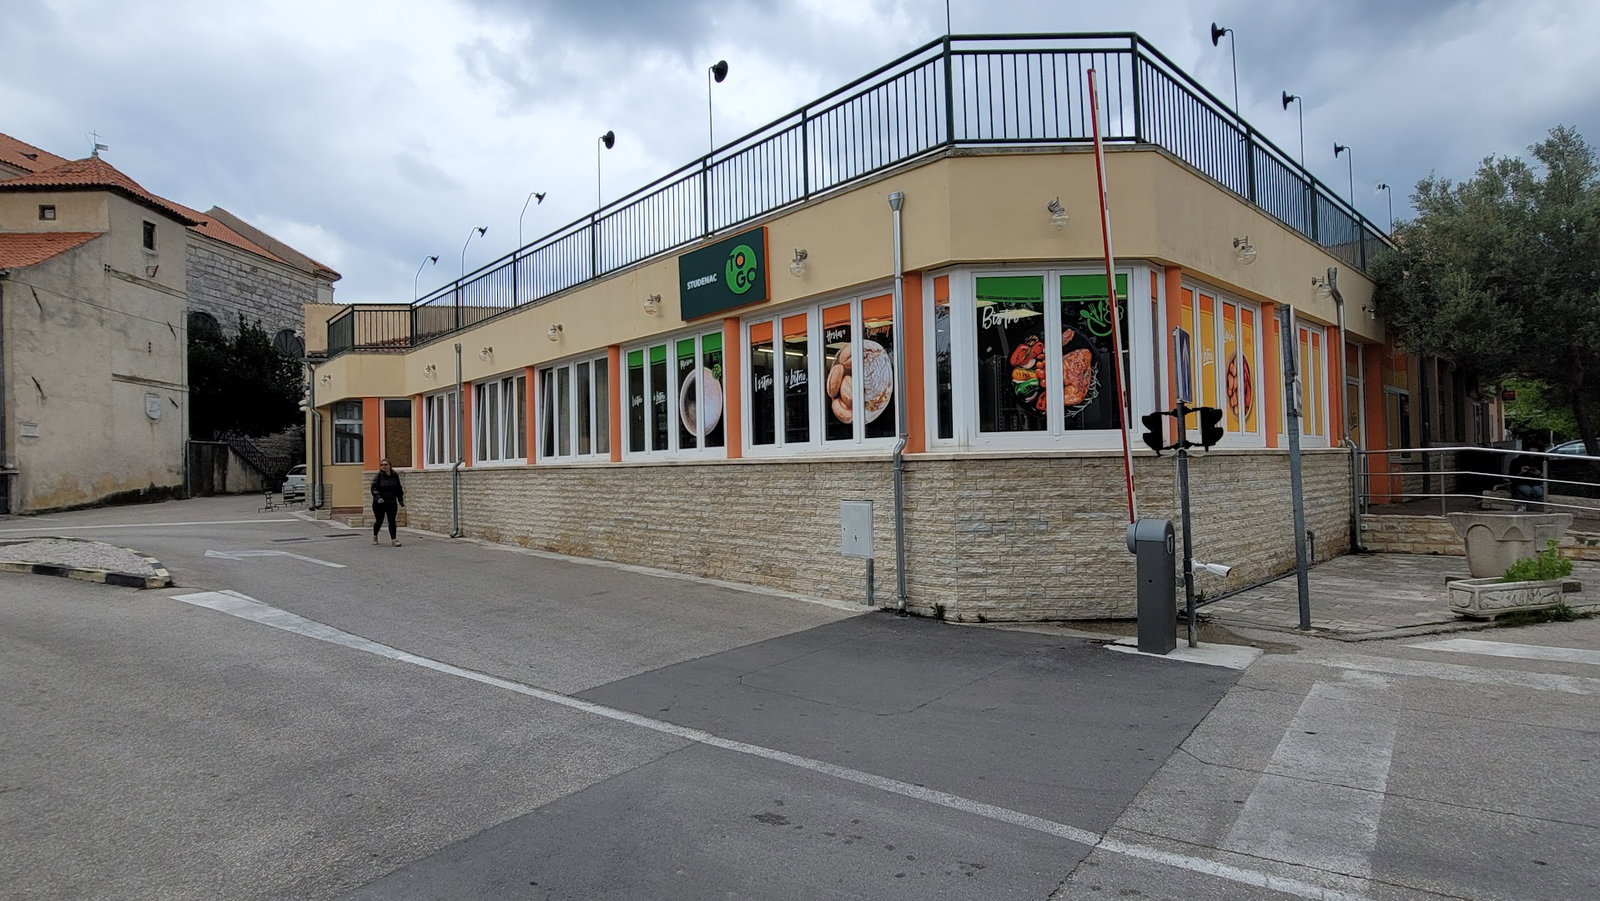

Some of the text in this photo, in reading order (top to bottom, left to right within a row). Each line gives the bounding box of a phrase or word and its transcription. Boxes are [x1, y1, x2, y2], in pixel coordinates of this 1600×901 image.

[729, 252, 745, 272] TO
[686, 273, 718, 290] STUDENAC
[736, 267, 757, 288] GO
[982, 305, 1019, 330] Bistro
